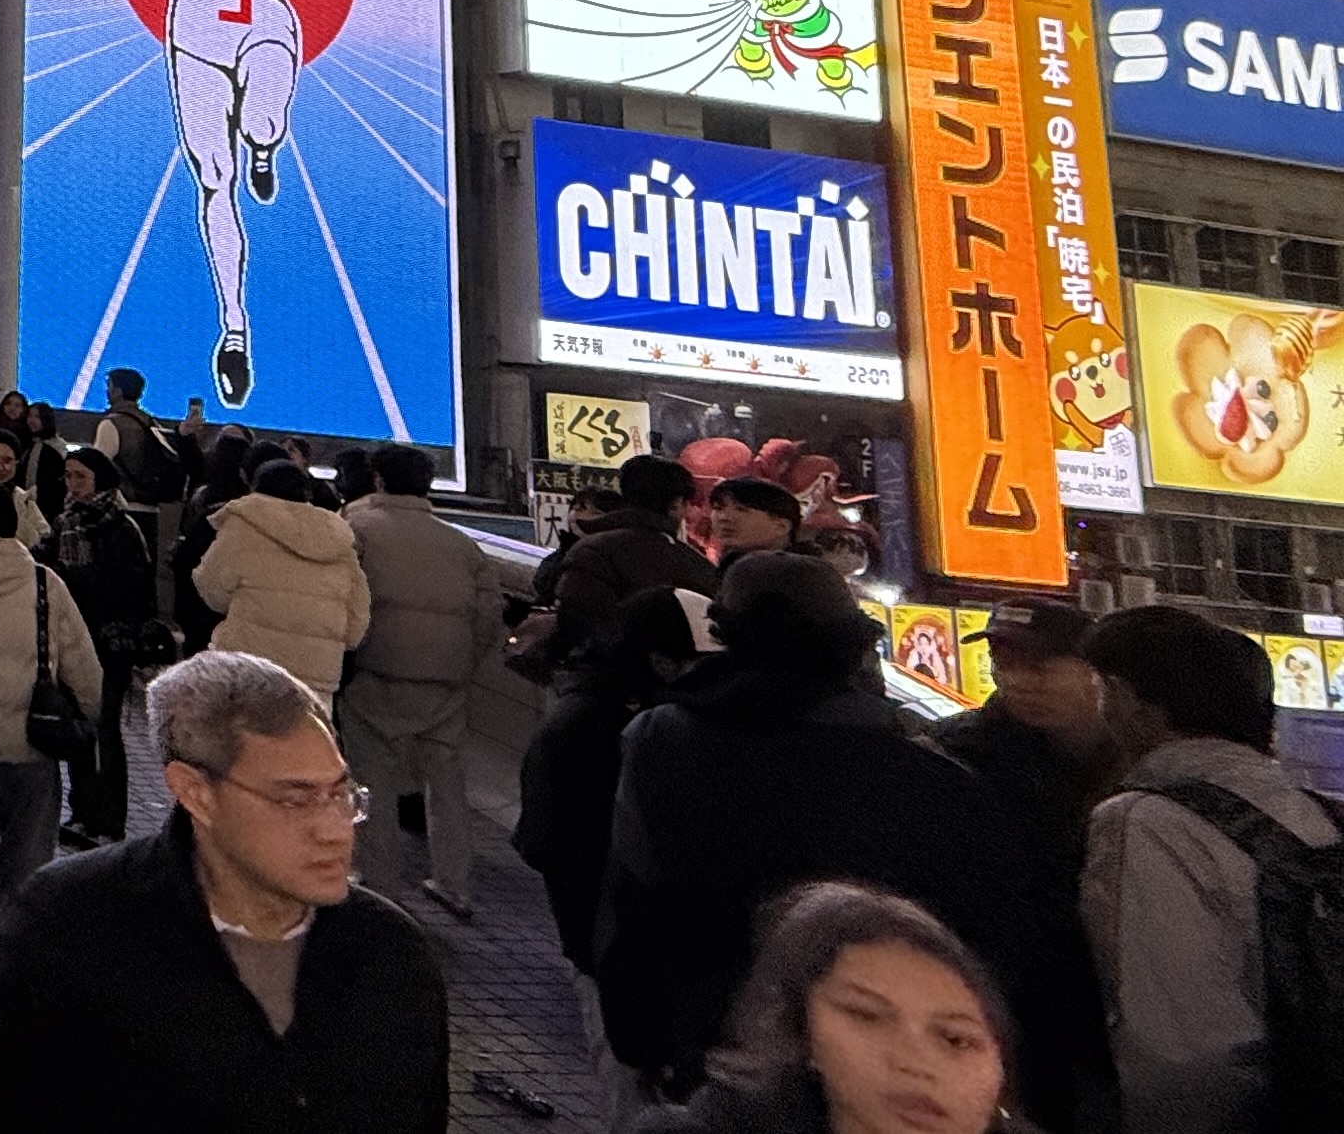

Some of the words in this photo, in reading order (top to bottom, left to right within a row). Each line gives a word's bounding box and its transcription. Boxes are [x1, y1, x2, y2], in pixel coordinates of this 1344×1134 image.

[1183, 20, 1344, 112] SAM
[557, 159, 876, 328] CHINTAI
[567, 405, 631, 459] くくる
